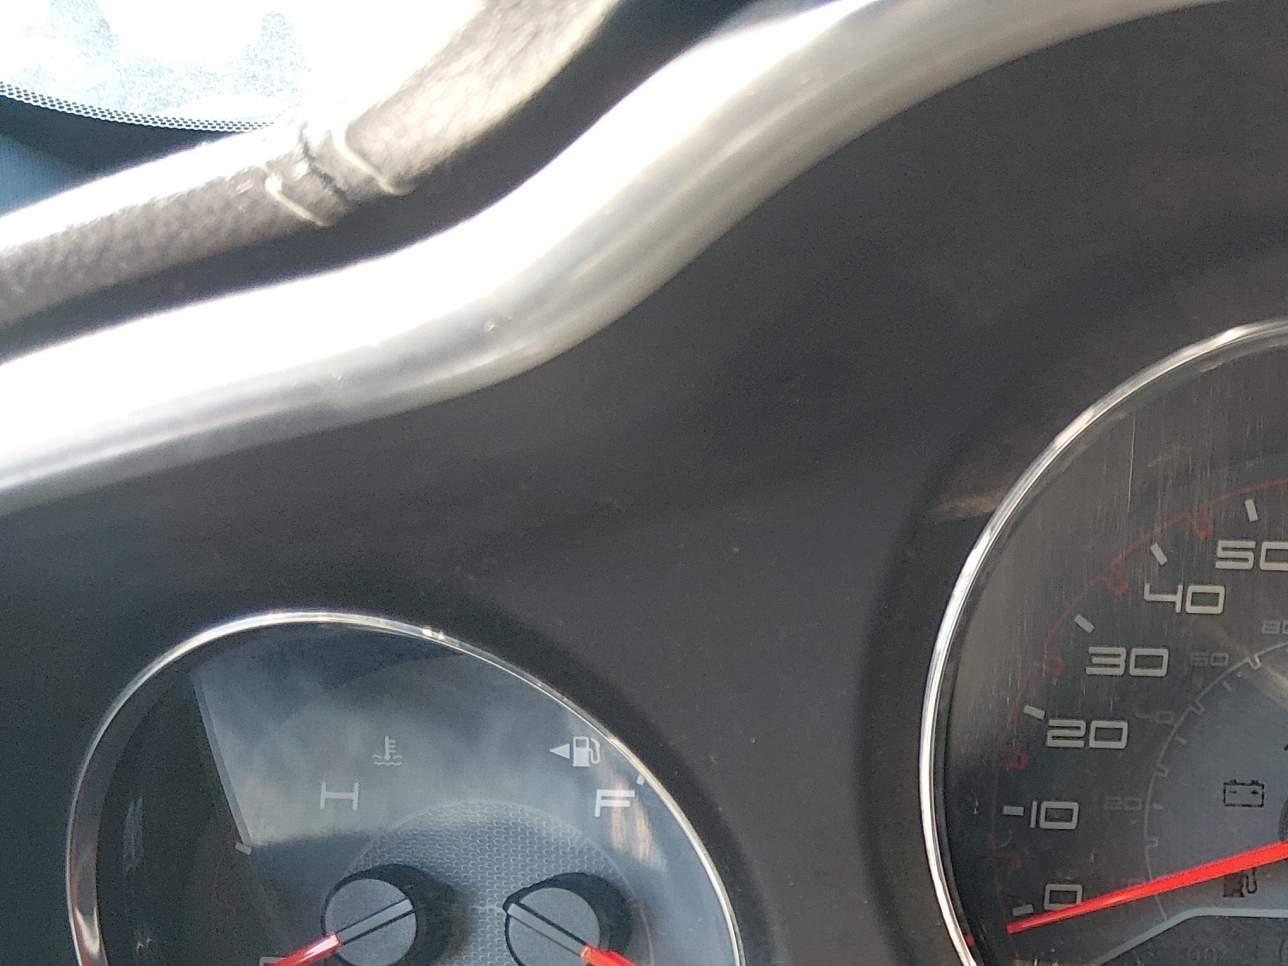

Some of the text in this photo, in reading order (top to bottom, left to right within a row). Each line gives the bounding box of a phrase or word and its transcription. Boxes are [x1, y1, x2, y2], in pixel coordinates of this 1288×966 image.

[1144, 582, 1226, 615] 40
[1086, 646, 1169, 677] 30
[1046, 718, 1129, 749] 20
[319, 781, 360, 812] H
[594, 788, 636, 818] F
[1029, 800, 1080, 830] 10
[1043, 883, 1084, 911] 0
